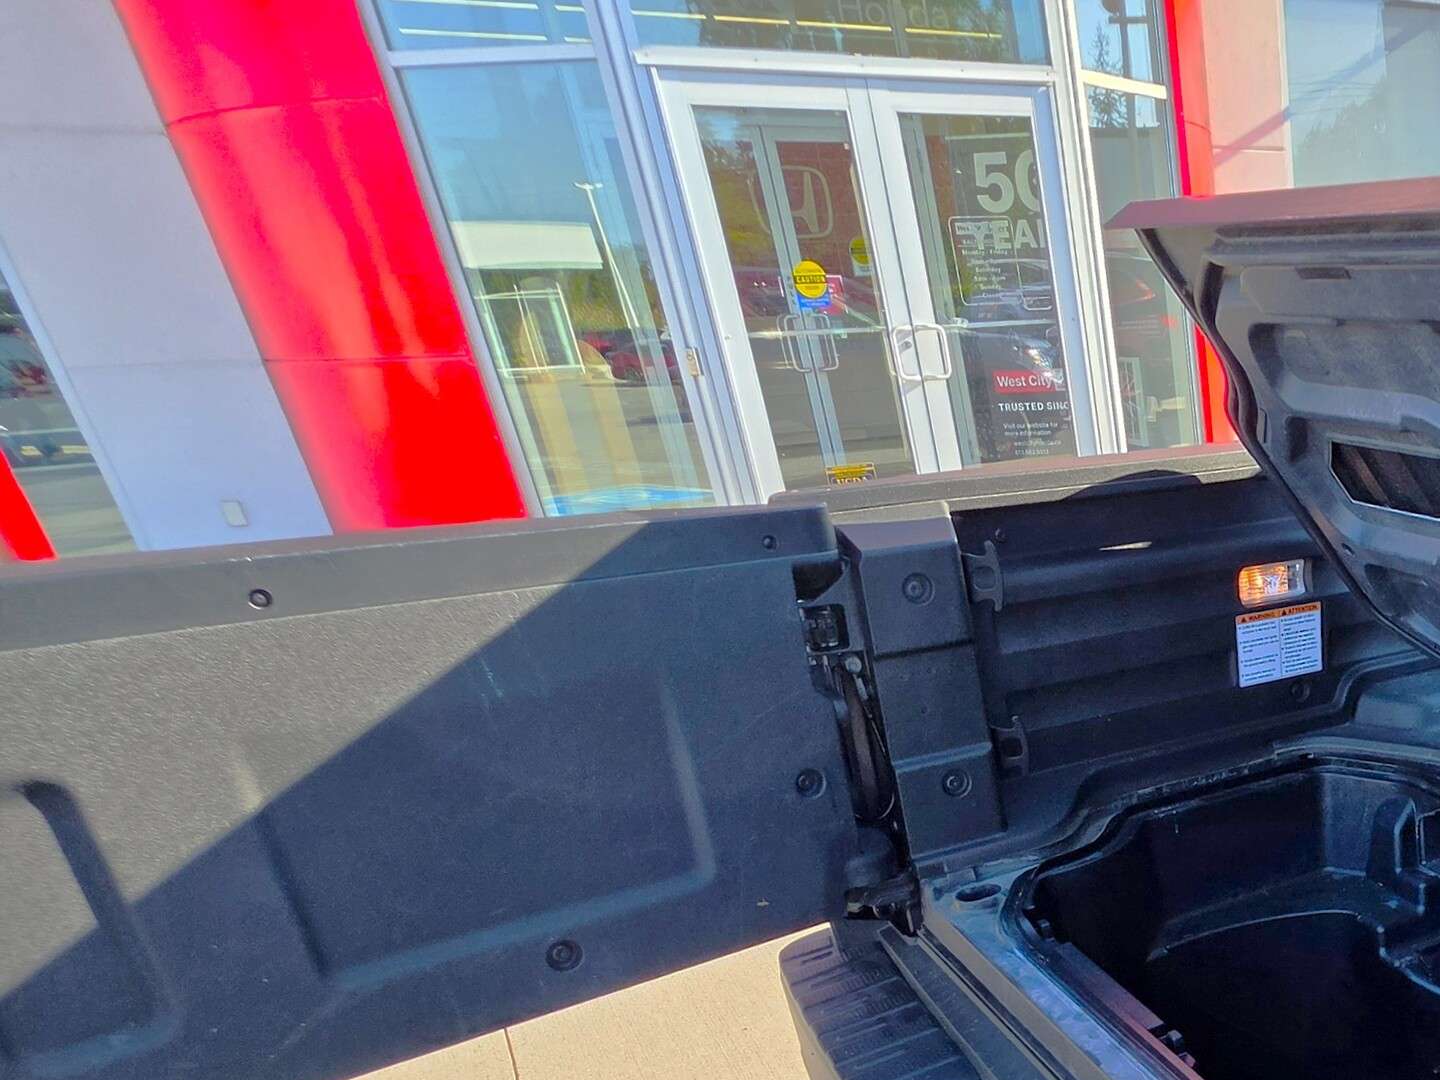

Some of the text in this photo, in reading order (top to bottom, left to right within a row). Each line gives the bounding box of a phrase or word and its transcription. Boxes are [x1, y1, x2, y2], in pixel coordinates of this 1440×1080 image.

[838, 0, 949, 28] Hoda
[996, 375, 1052, 389] West City
[998, 402, 1043, 412] TRUSTED
